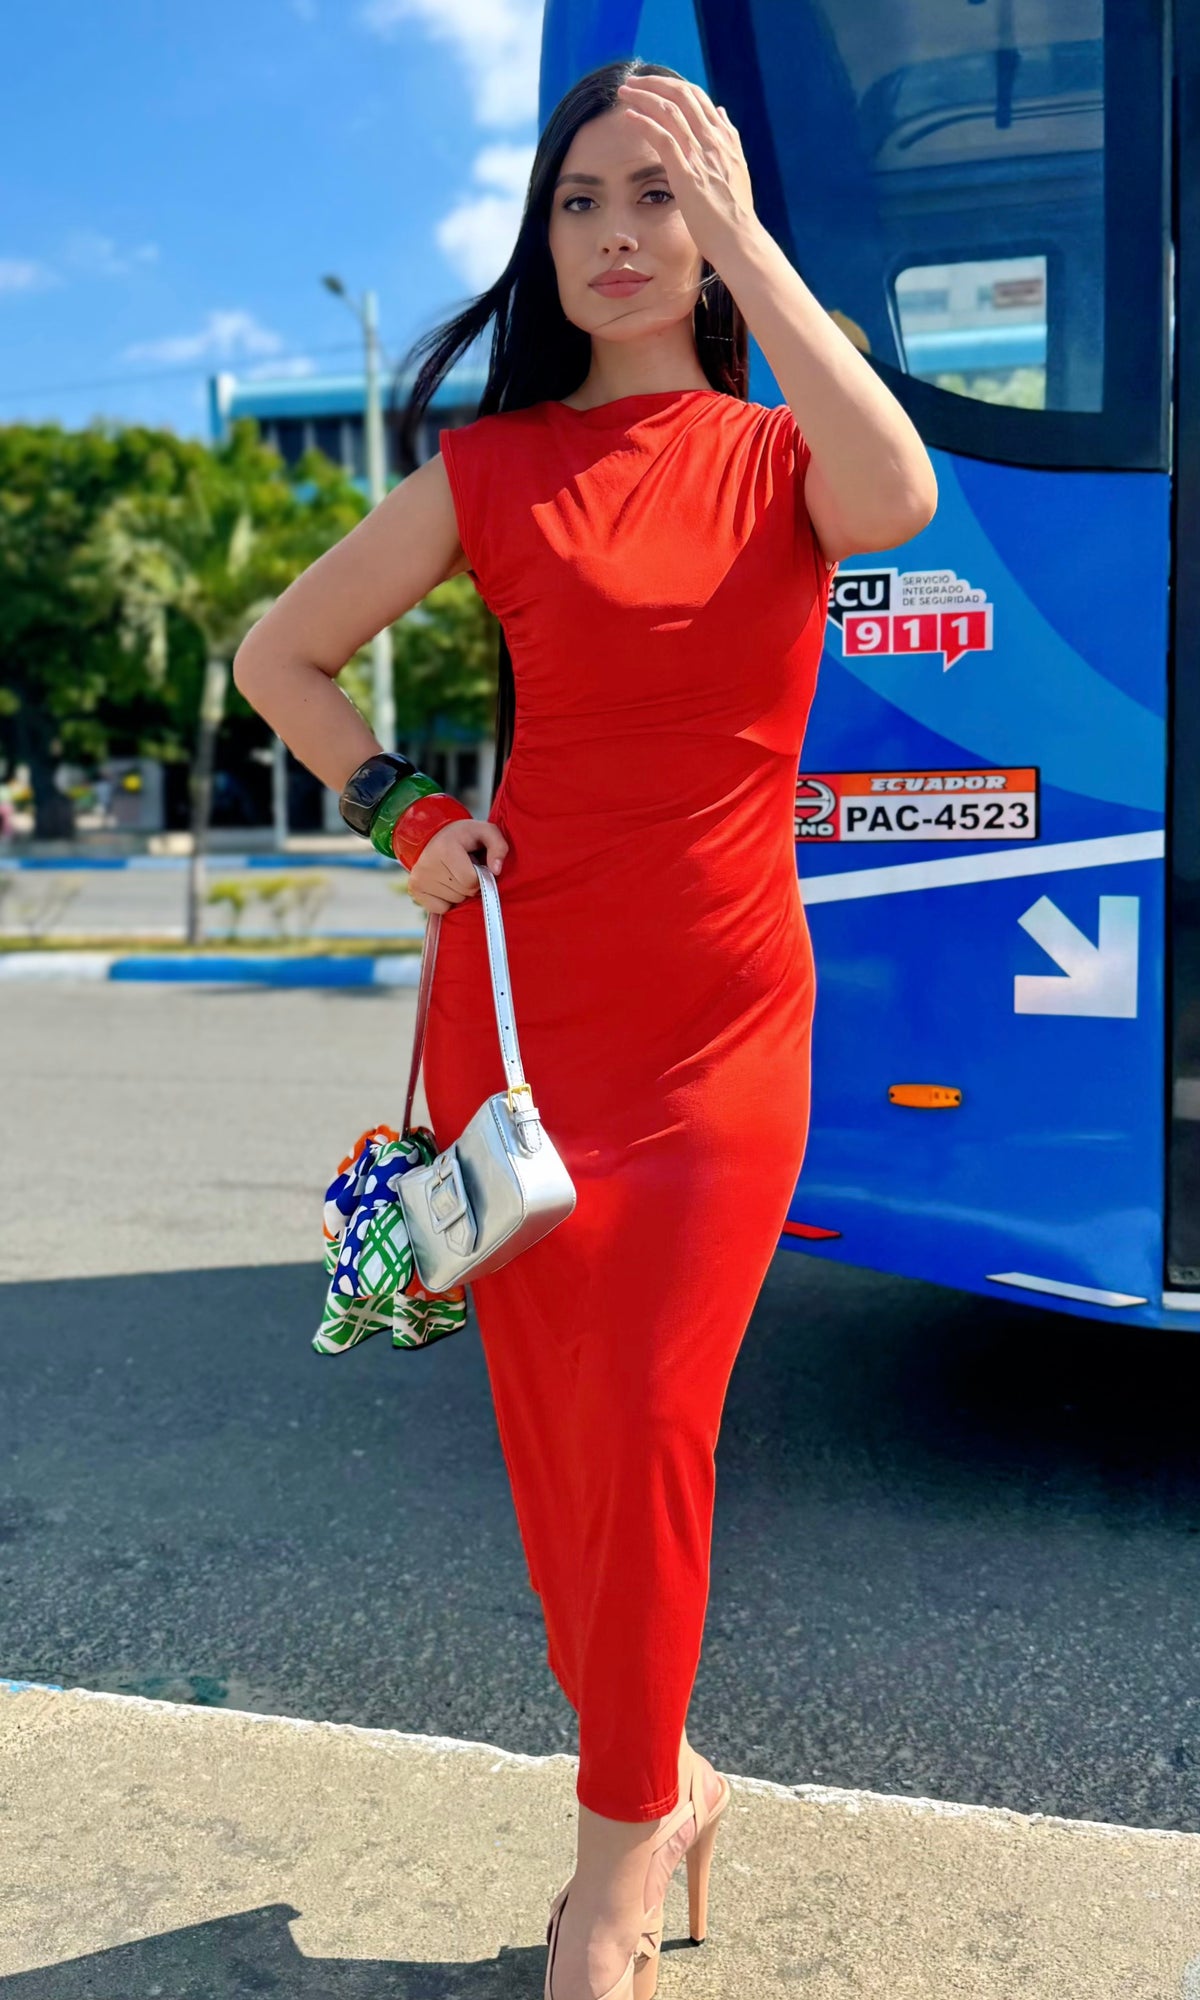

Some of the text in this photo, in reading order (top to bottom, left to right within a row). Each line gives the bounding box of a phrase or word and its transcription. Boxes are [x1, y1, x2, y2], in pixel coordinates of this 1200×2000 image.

[902, 575, 950, 586] SERVICIO
[902, 585, 964, 596] INTEGRADO
[902, 594, 980, 606] DE SEGURIDAD
[855, 615, 969, 652] 911
[870, 775, 1007, 792] ECUADOR
[846, 802, 1030, 833] PAC-4523
